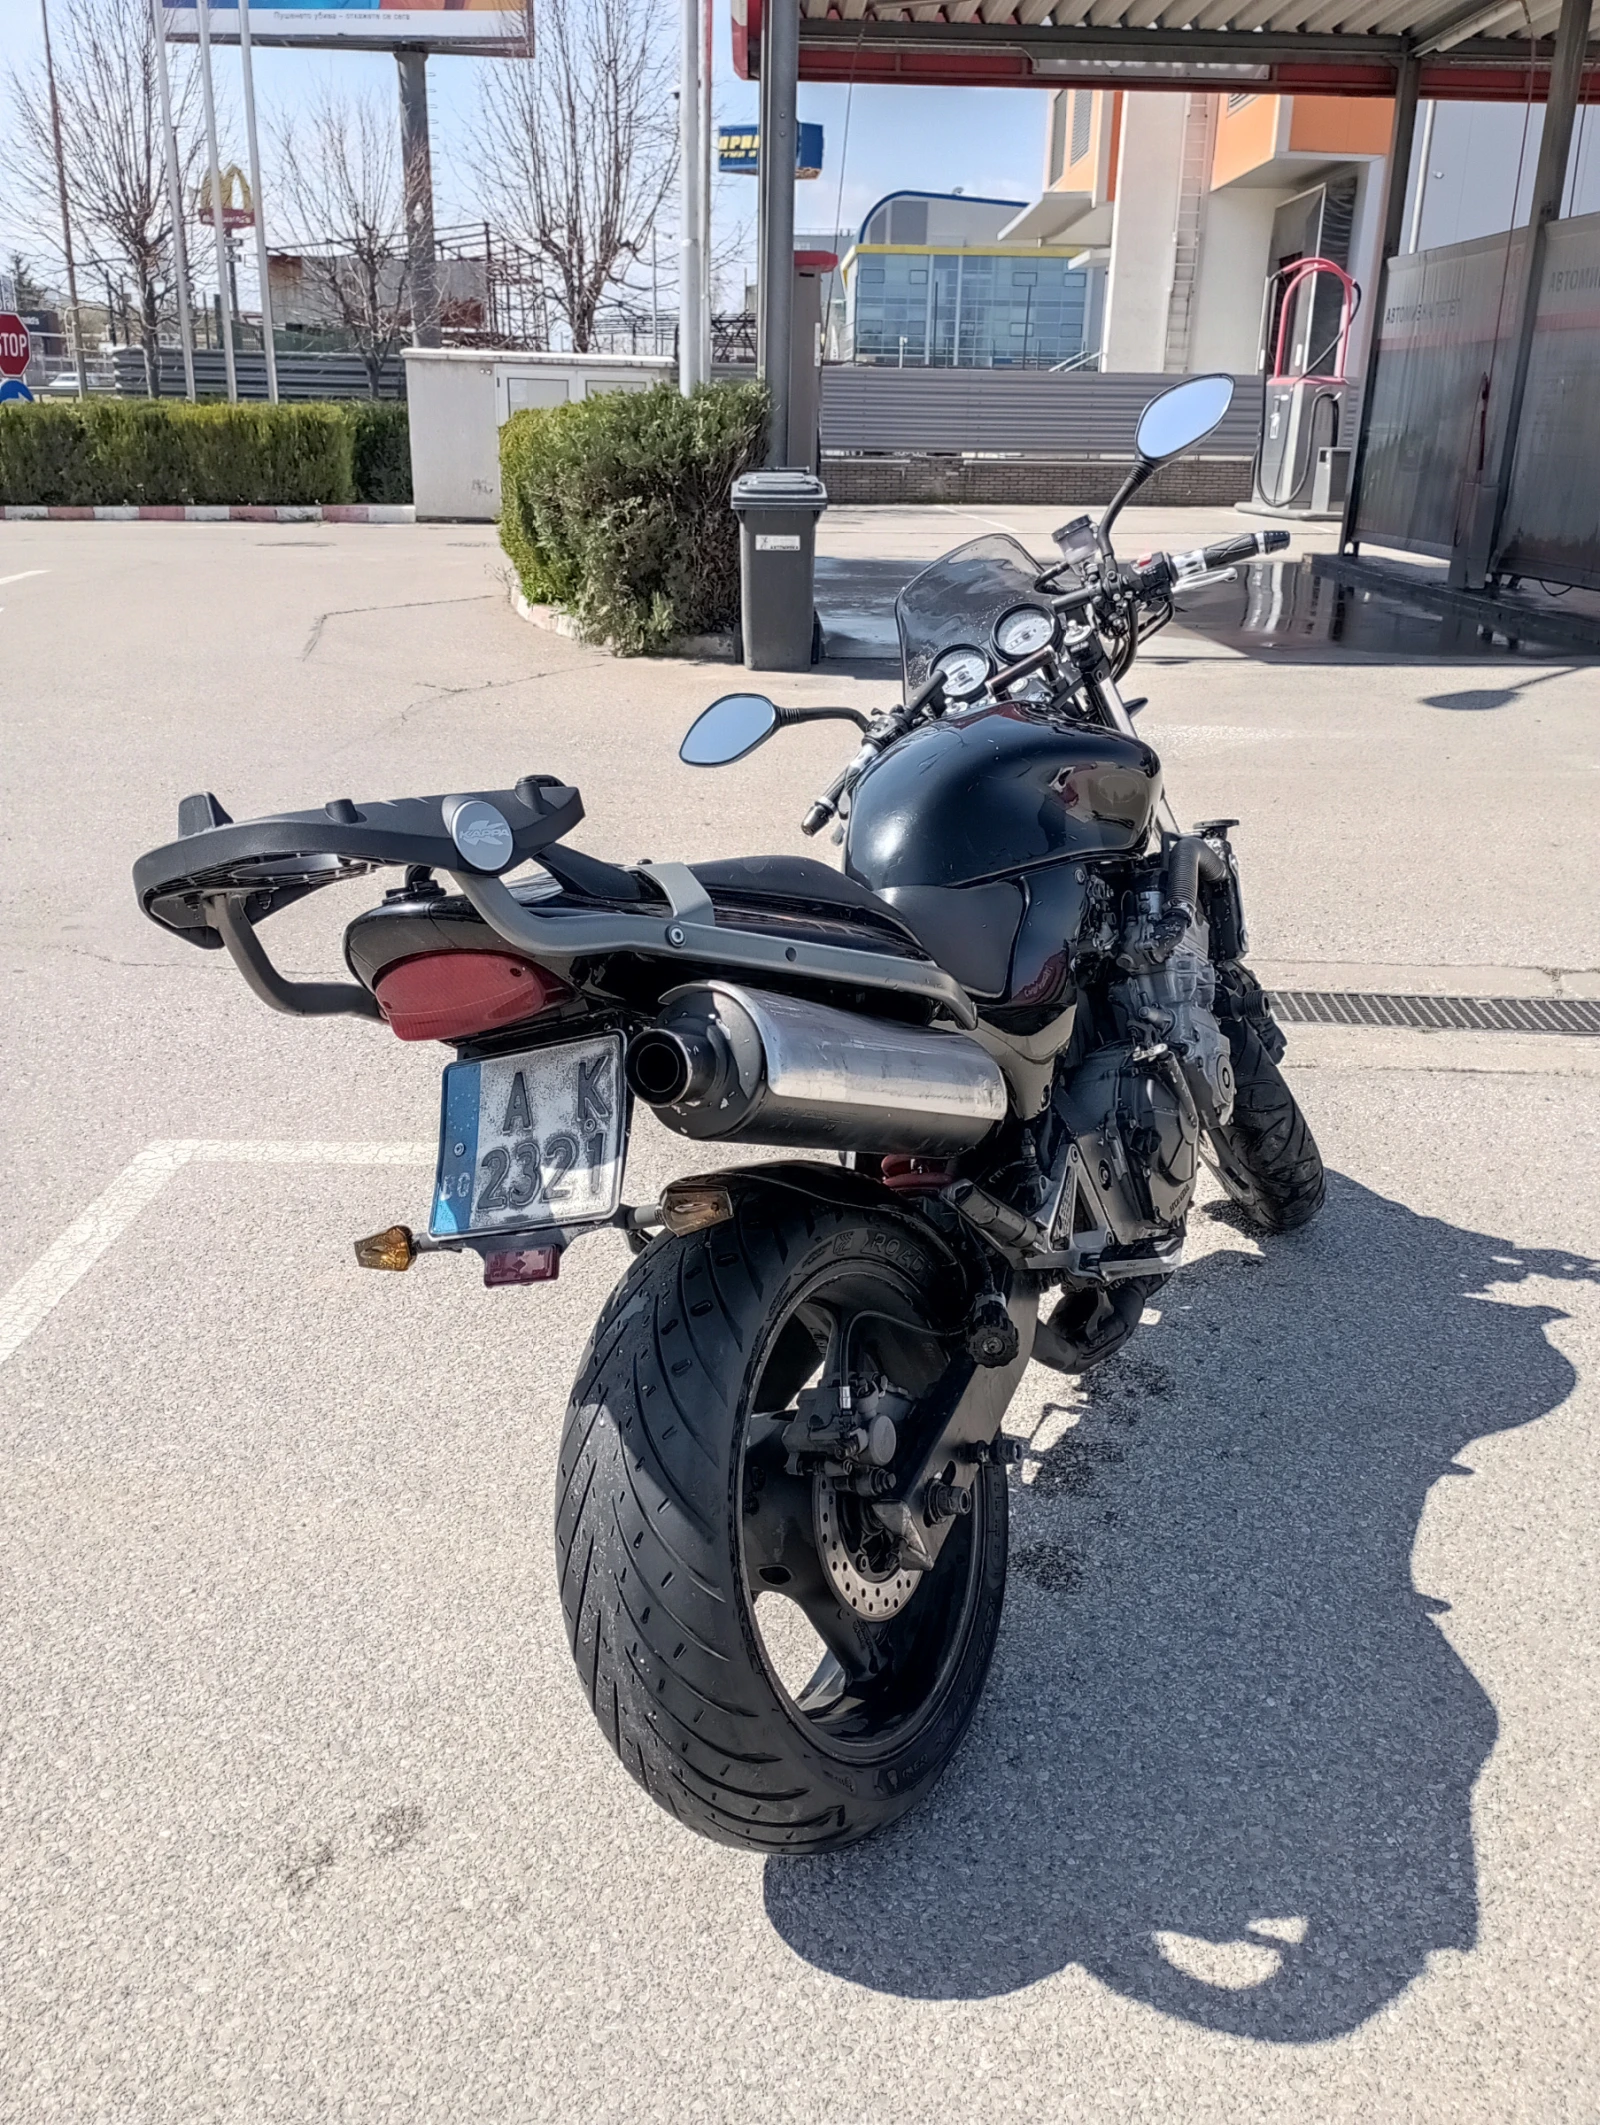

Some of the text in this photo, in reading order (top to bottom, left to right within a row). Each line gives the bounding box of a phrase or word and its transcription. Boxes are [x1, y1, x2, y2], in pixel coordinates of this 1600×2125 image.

[0, 333, 27, 357] TOP
[460, 828, 510, 839] KAPPA
[476, 1132, 607, 1212] 2321
[1168, 1183, 1191, 1215] HONDA
